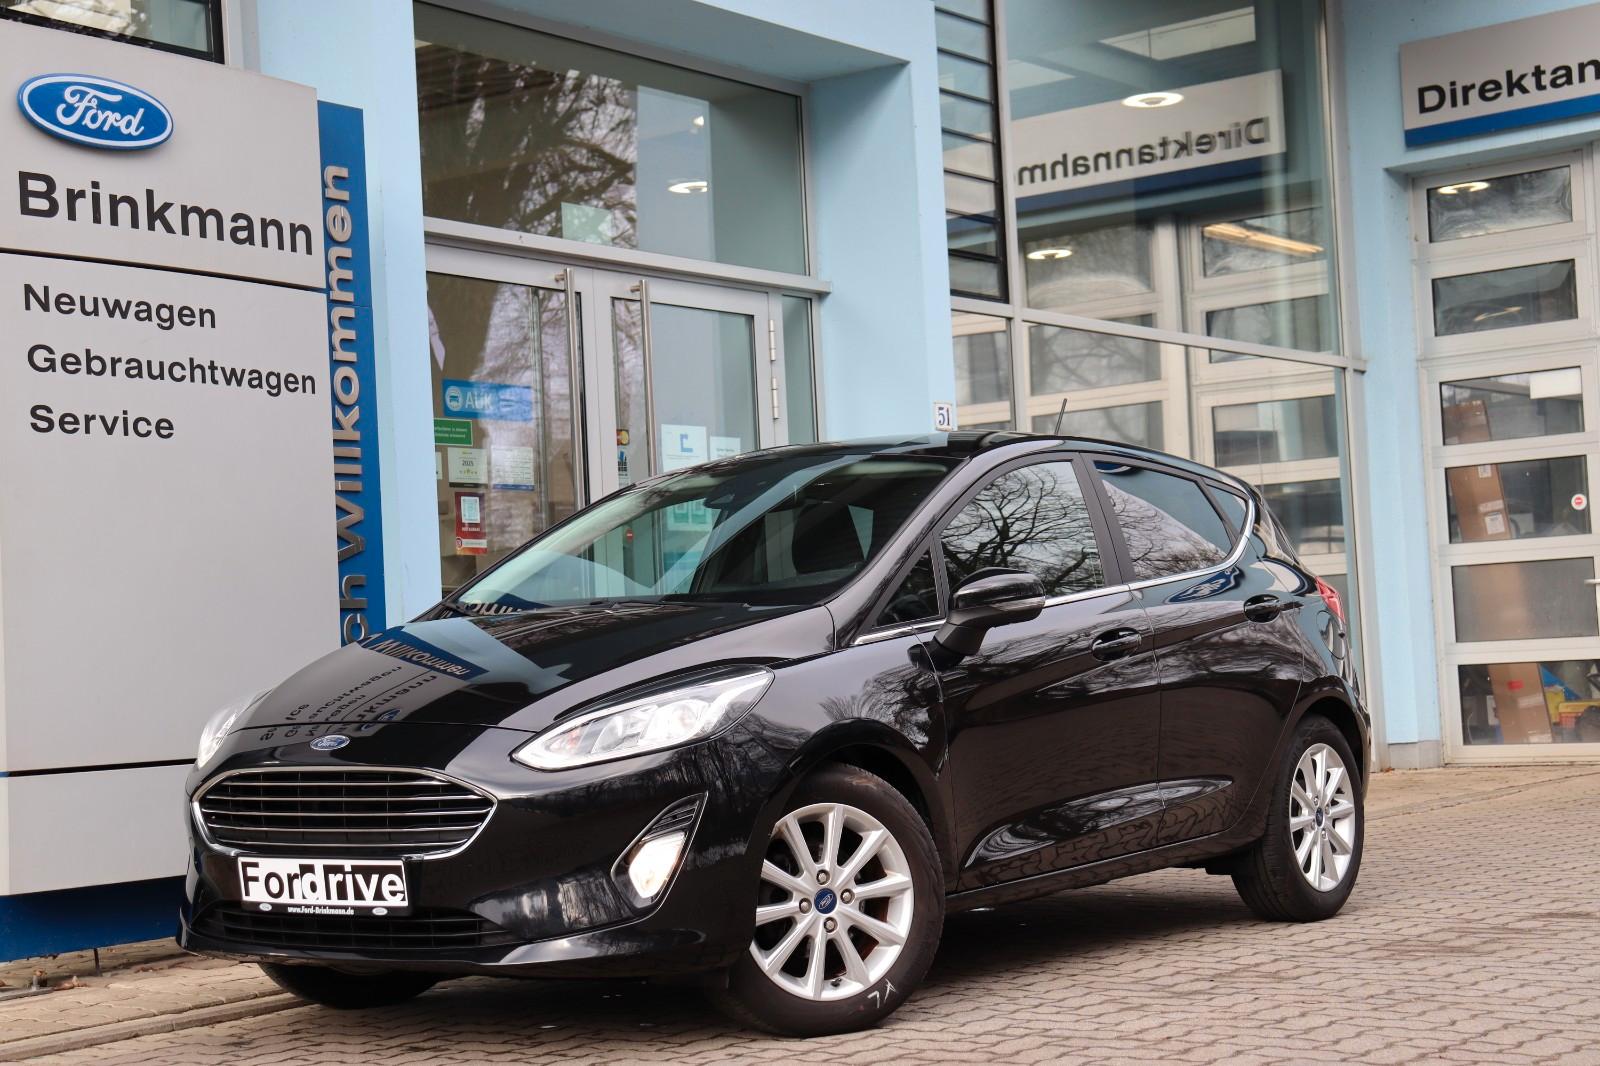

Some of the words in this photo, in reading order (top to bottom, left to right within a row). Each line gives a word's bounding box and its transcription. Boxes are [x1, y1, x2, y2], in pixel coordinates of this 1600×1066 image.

[56, 85, 145, 138] Ford
[1417, 58, 1600, 114] Direktan
[18, 170, 313, 256] Brinkmann
[23, 283, 217, 330] Neuwagen
[27, 344, 316, 397] Gebrauchtwagen
[324, 165, 366, 562] Willkommen
[29, 404, 175, 439] Service
[938, 406, 950, 426] 51
[240, 861, 405, 902] Fordrive
